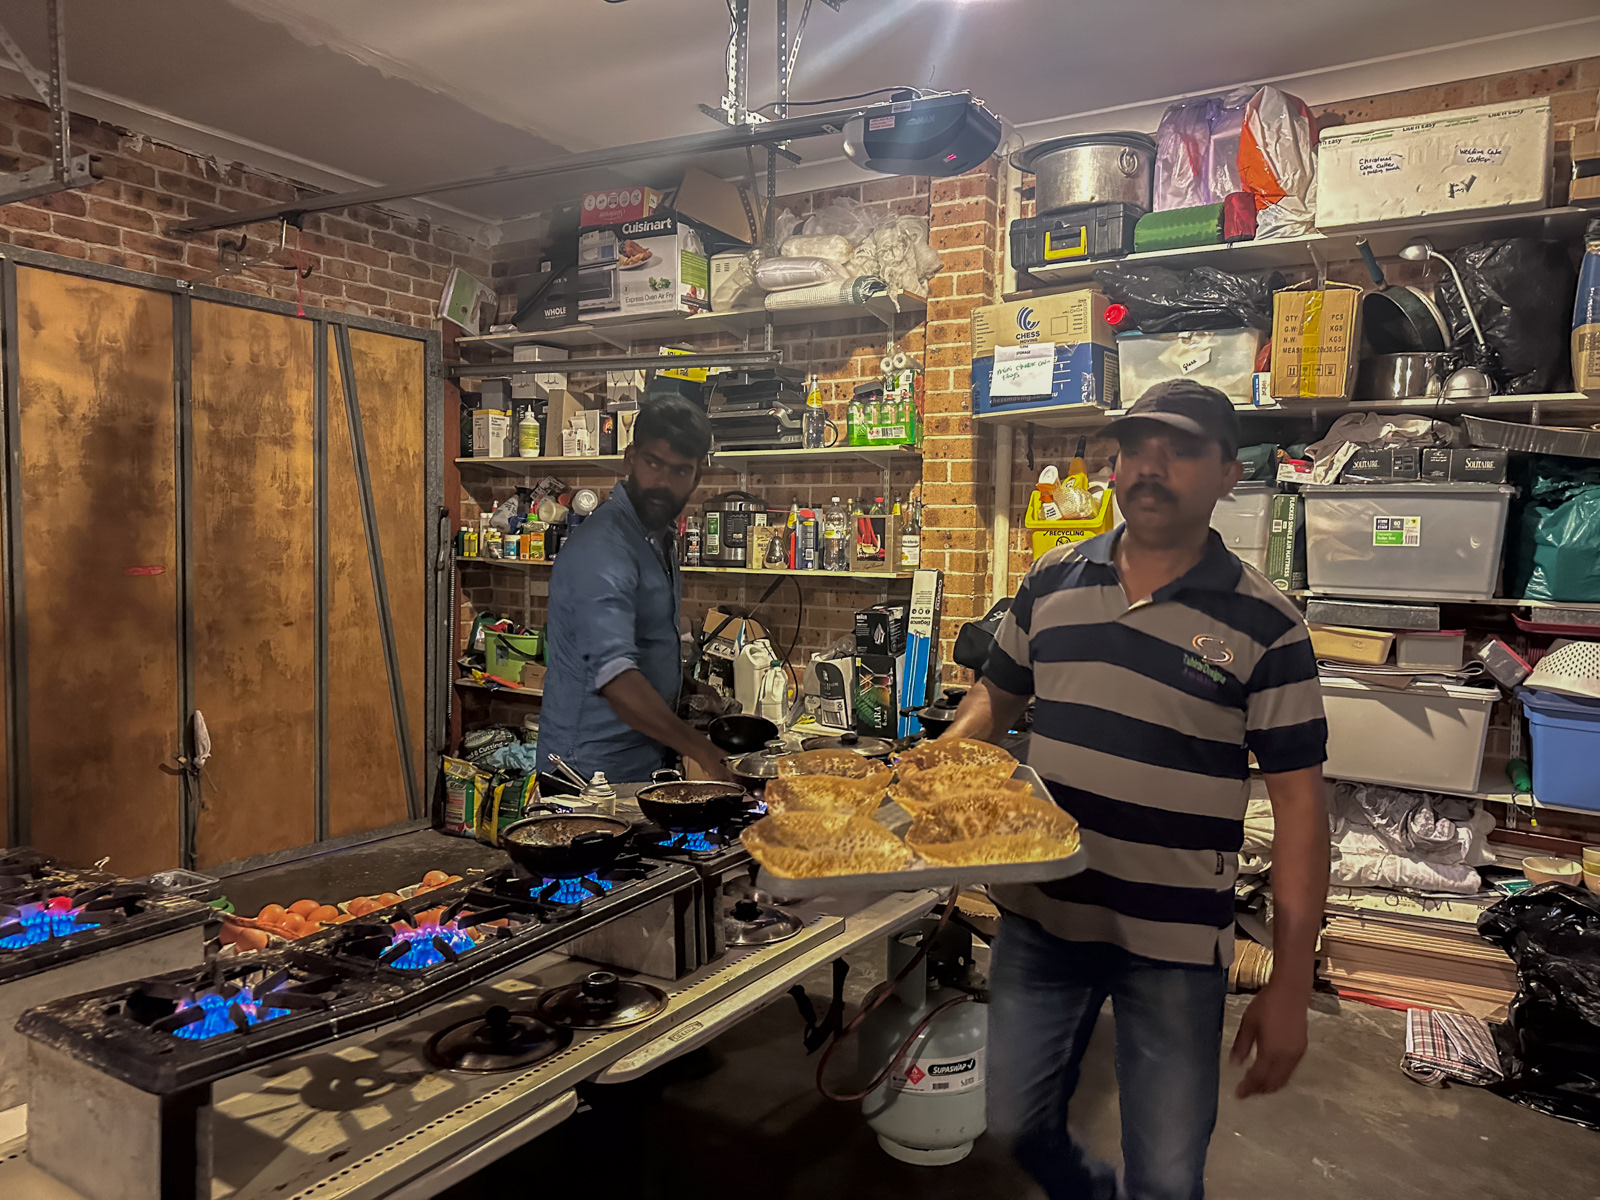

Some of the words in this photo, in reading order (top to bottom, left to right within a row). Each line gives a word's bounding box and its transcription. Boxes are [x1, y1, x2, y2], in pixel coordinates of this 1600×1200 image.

[621, 217, 673, 235] Cuisinart
[544, 306, 567, 317] WHOLE
[1331, 313, 1344, 321] PCS
[1015, 330, 1041, 340] CHESS
[1287, 496, 1296, 521] FLOCKED
[1286, 521, 1294, 539] SINGLE
[1285, 540, 1293, 550] AIR
[1283, 550, 1292, 578] MATTRESS
[874, 706, 882, 729] LARA
[478, 741, 504, 754] Cutting
[932, 1063, 968, 1074] SUPASWAP
